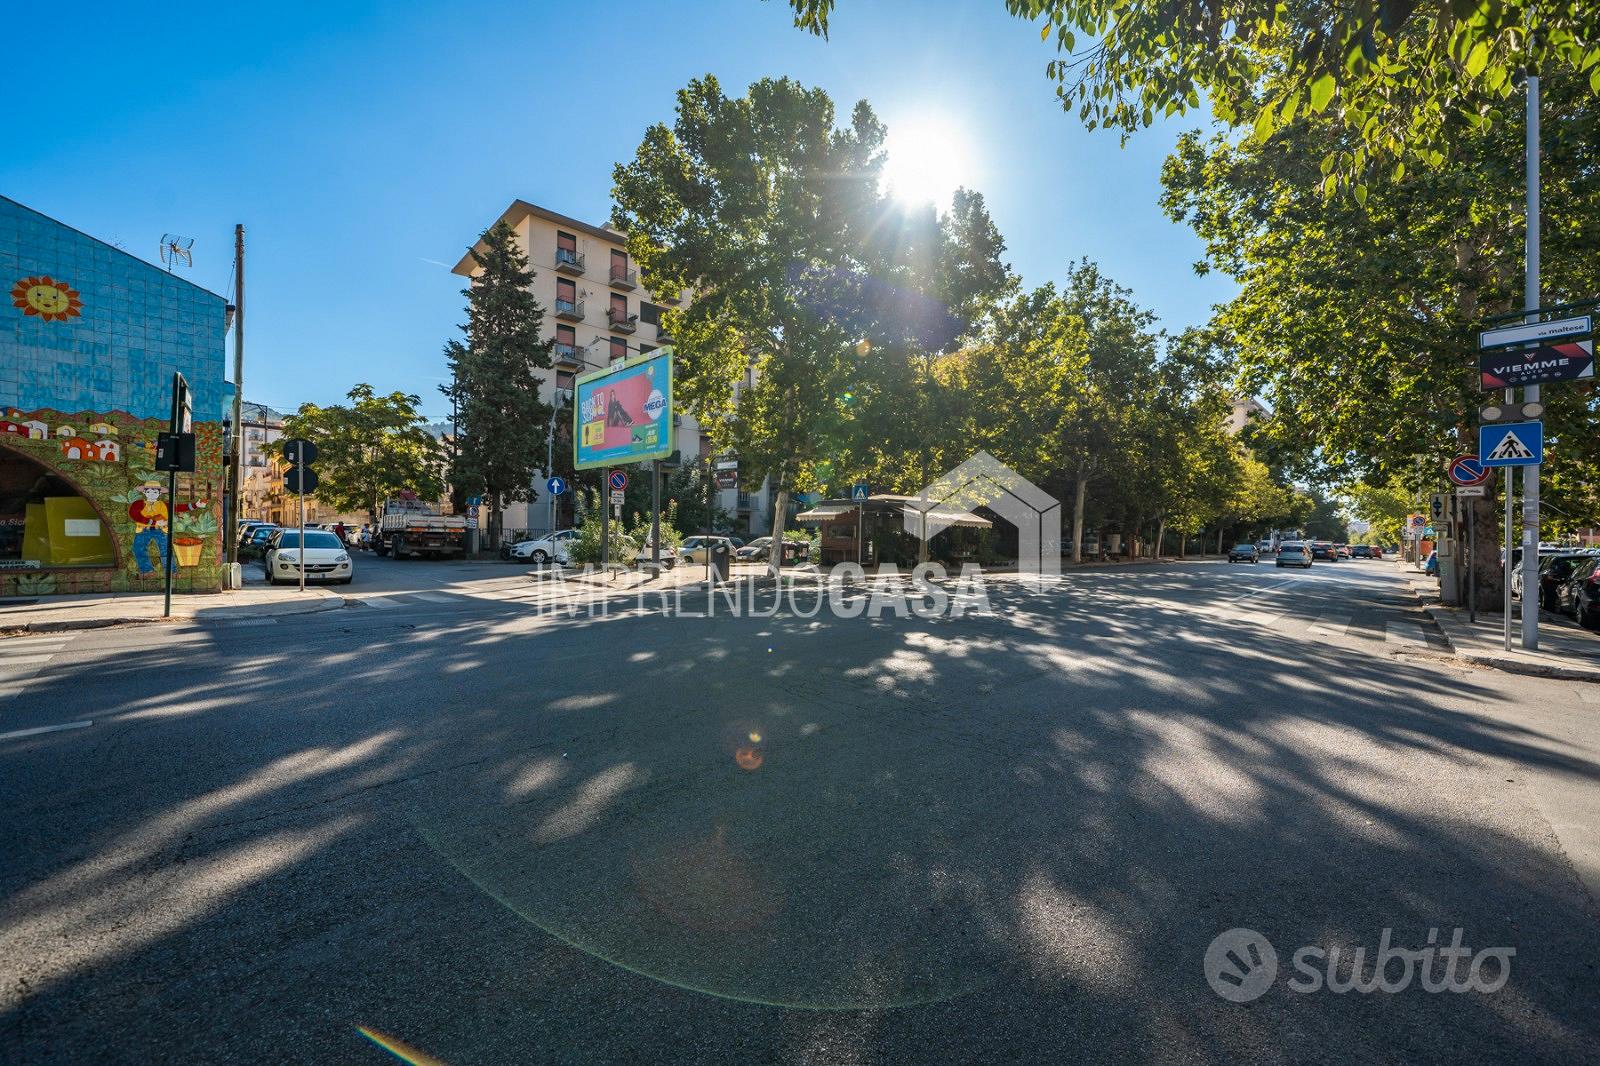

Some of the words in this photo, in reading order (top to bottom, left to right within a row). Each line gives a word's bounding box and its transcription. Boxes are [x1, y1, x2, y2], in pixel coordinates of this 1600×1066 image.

[1549, 325, 1585, 334] maltese
[1493, 358, 1569, 374] VIEMME
[644, 399, 667, 411] MEGA
